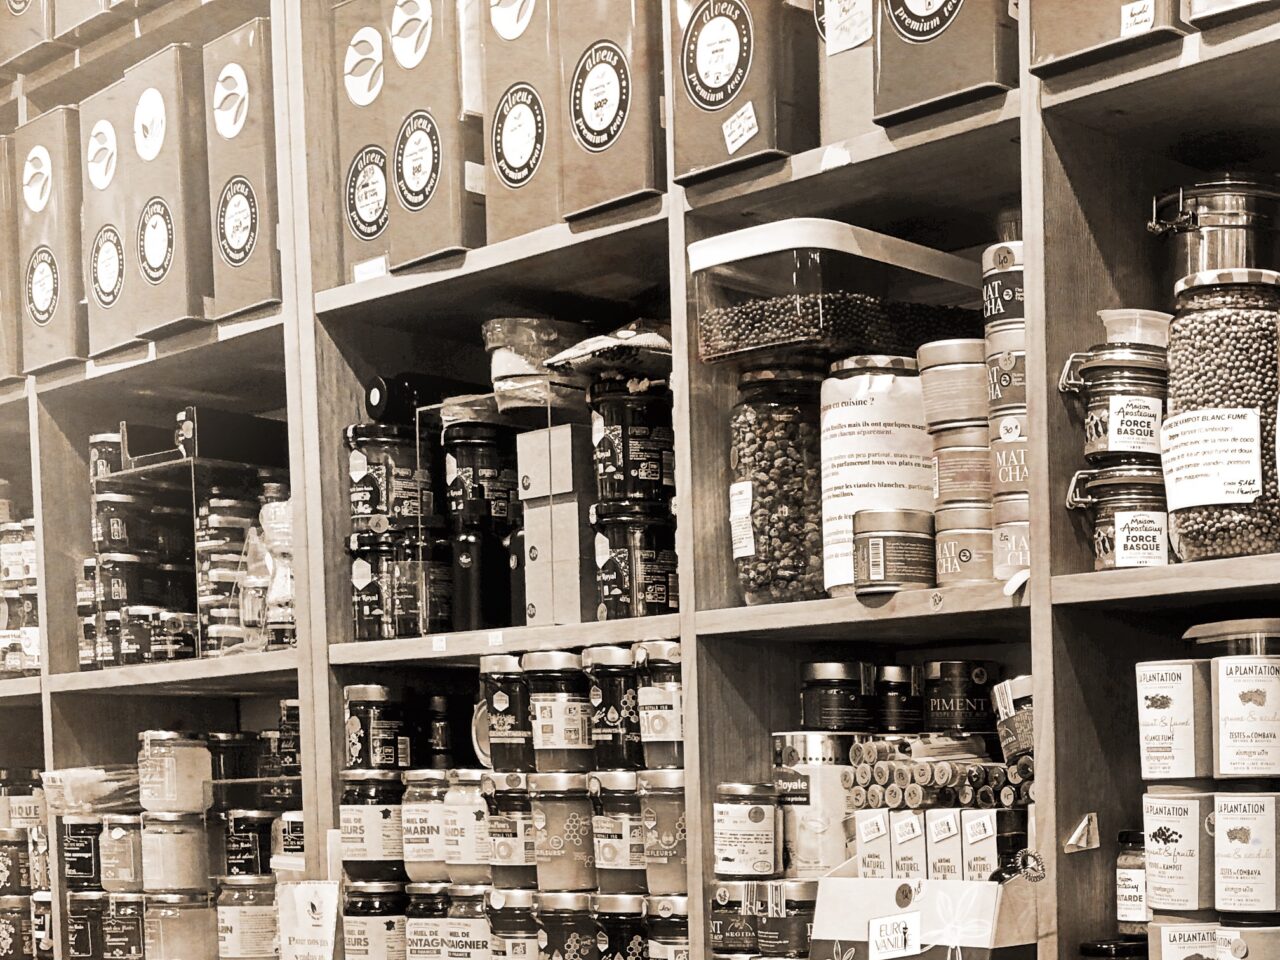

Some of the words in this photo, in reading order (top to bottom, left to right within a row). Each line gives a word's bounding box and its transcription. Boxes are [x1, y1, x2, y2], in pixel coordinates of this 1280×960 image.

[585, 47, 618, 72] alveus
[503, 90, 532, 115] alveus
[1121, 420, 1151, 428] FORCE
[1117, 429, 1154, 437] BASQUE
[1226, 666, 1234, 676] LA
[1235, 665, 1280, 676] PLANTATION
[931, 698, 985, 711] PIMENT
[1150, 807, 1188, 816] PLANTATION
[1224, 803, 1265, 813] PLANTATION
[880, 921, 908, 937] EURO
[1169, 933, 1177, 943] LA
